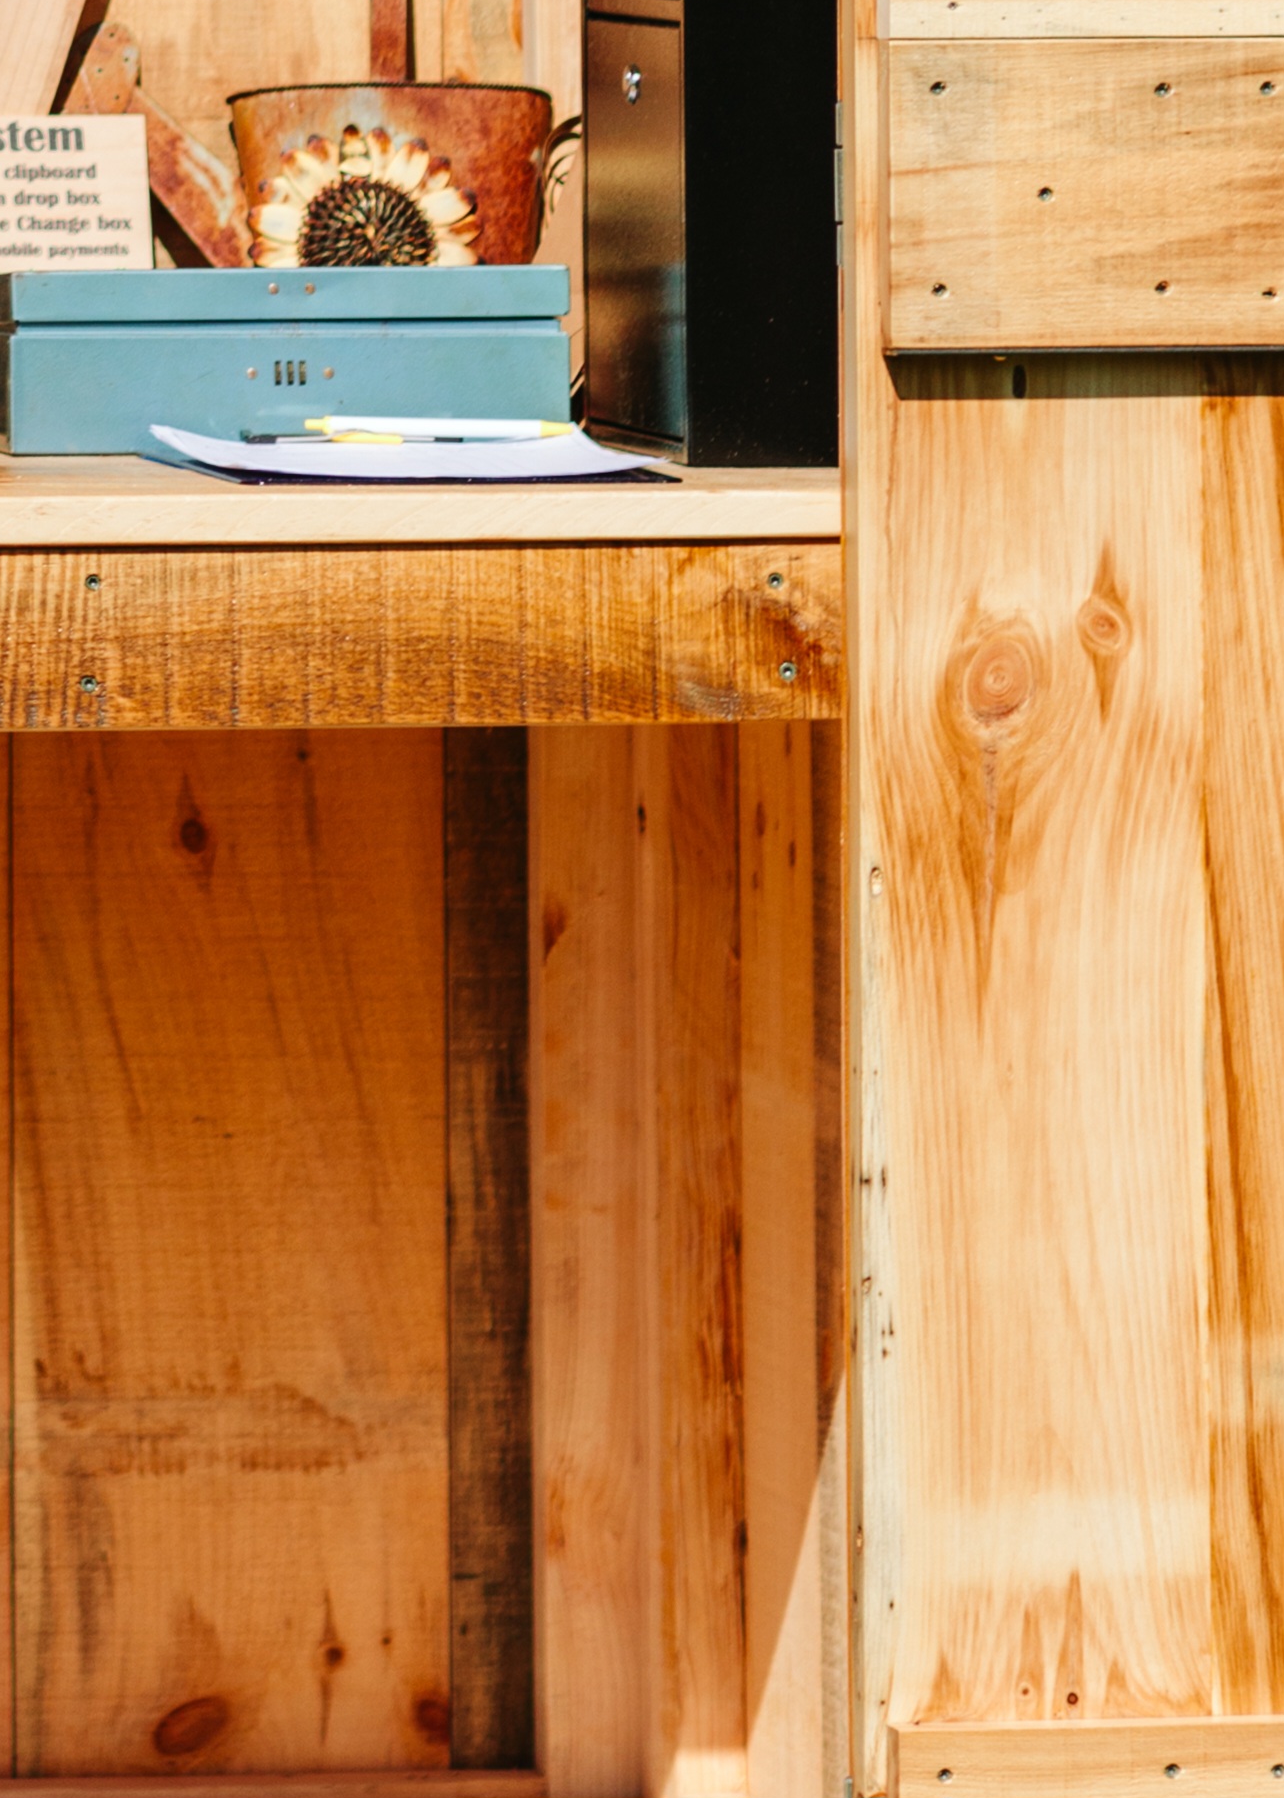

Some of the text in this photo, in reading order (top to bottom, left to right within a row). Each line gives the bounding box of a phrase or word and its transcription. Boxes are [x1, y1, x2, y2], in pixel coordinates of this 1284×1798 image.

[4, 163, 97, 182] clipboard
[14, 190, 59, 208] drop
[67, 190, 101, 204] box
[17, 216, 90, 233] Change
[98, 215, 132, 230] box
[48, 243, 129, 259] payments
